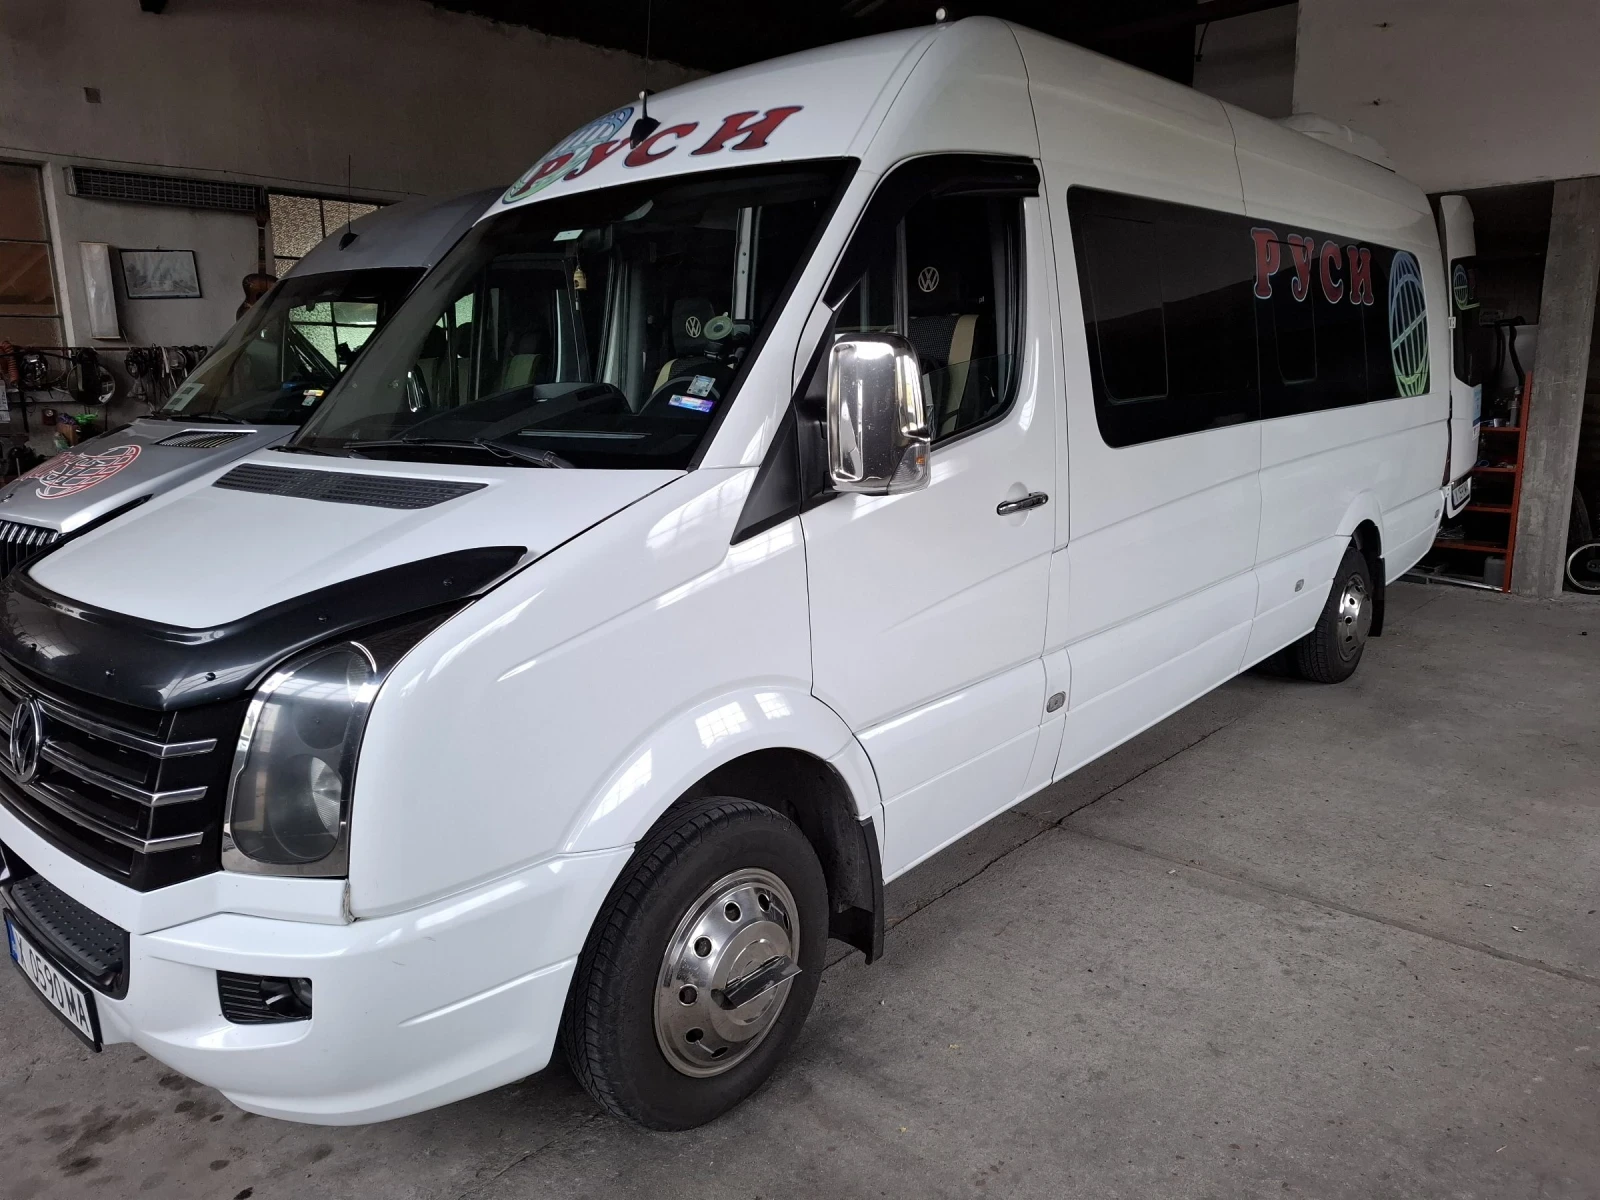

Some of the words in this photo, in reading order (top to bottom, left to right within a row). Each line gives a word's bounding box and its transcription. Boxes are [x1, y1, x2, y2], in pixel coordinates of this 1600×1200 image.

[1250, 227, 1375, 306] РУСИ
[29, 948, 65, 1009] 0590
[63, 981, 90, 1033] MA
